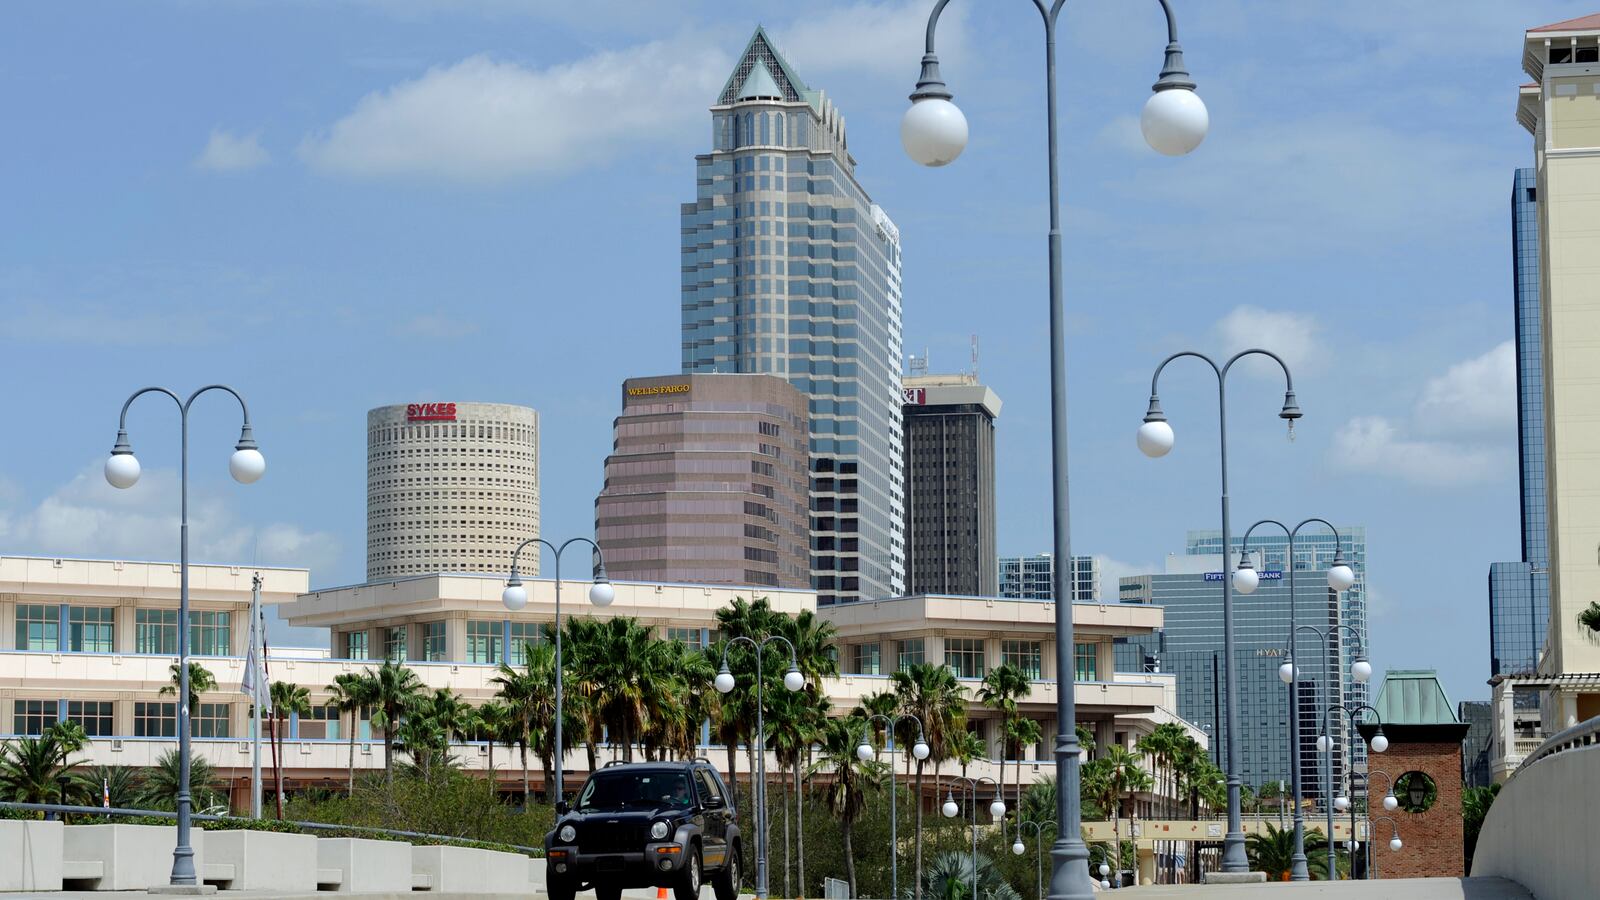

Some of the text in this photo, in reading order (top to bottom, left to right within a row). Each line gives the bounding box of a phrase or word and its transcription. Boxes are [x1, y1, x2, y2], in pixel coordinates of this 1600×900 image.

[629, 384, 690, 396] WELLS FARGO
[903, 388, 923, 405] &T
[407, 403, 456, 416] SYKES
